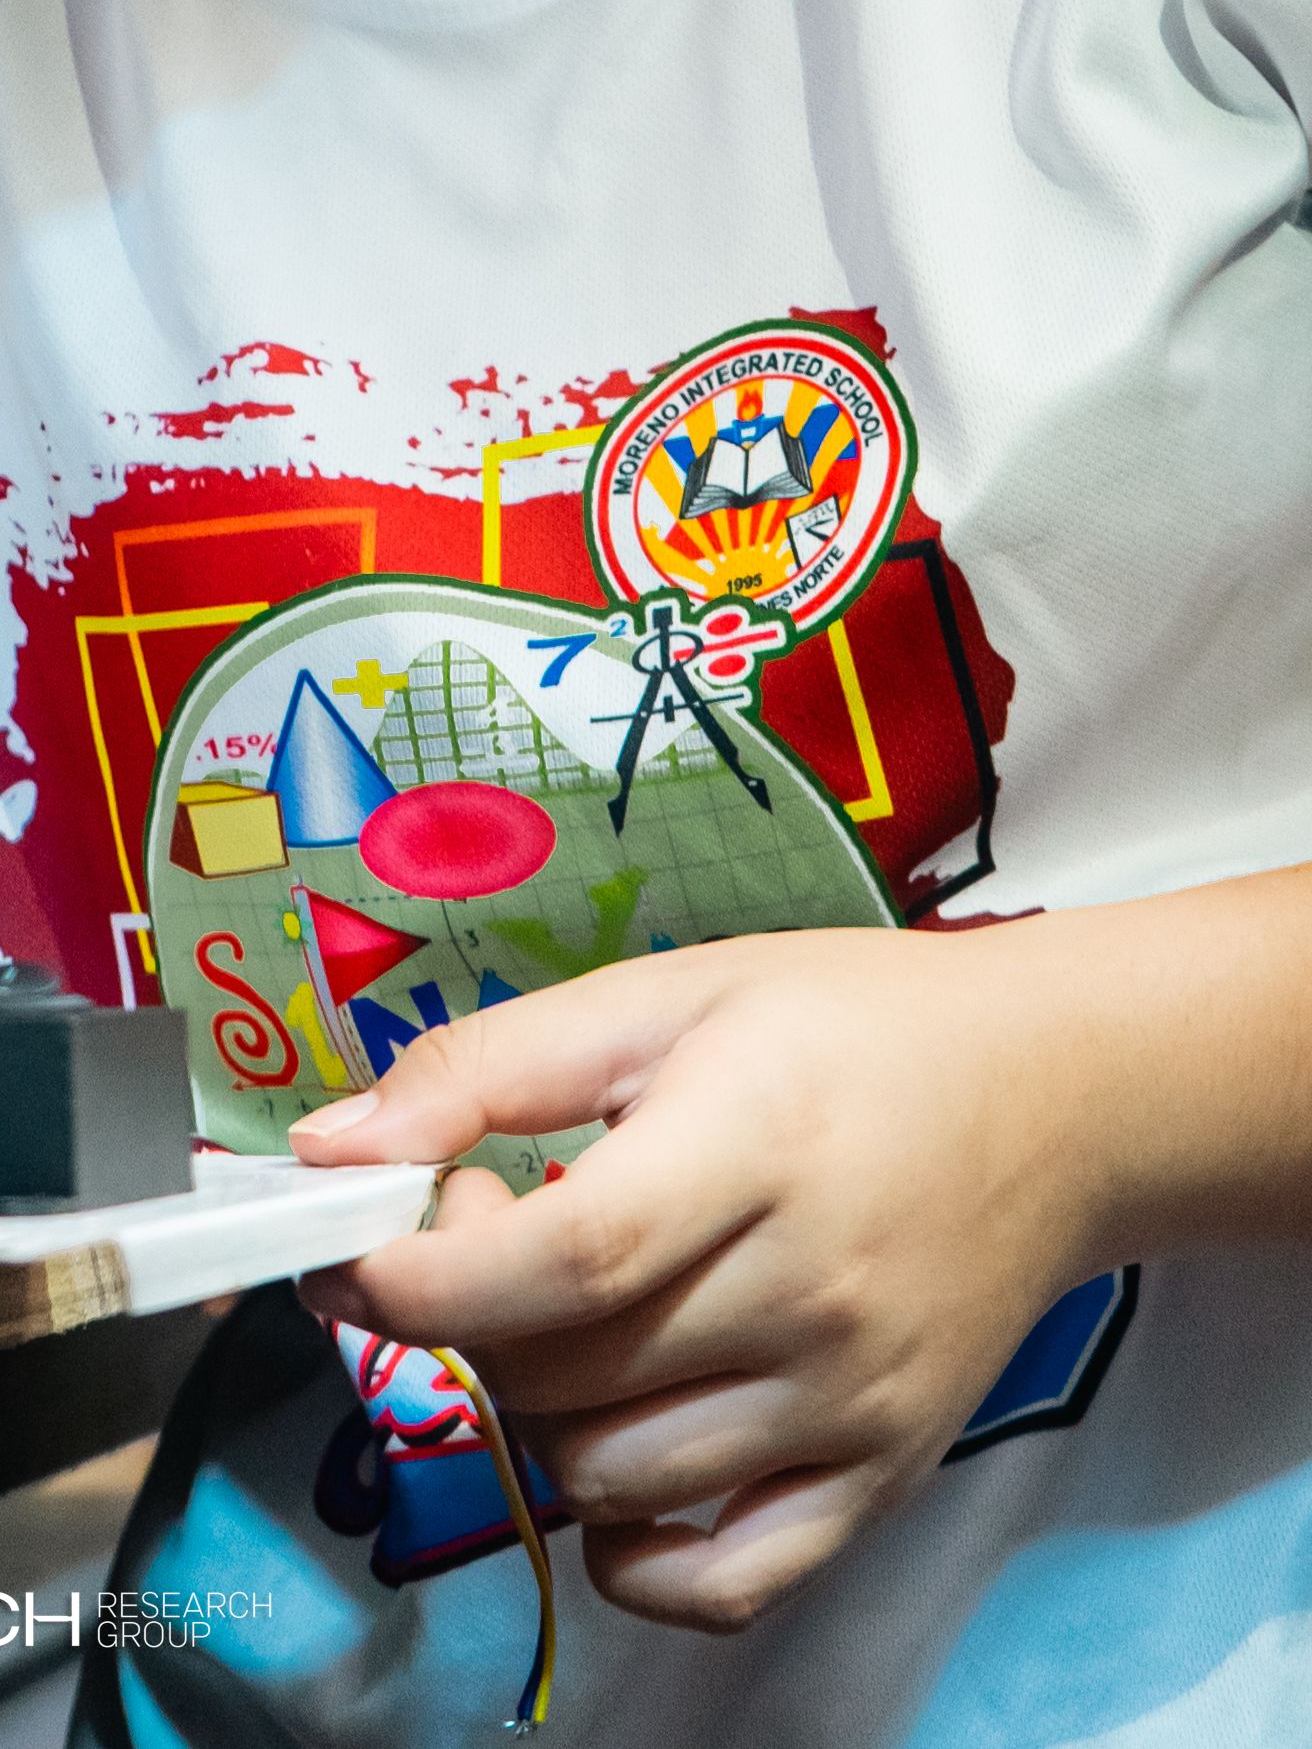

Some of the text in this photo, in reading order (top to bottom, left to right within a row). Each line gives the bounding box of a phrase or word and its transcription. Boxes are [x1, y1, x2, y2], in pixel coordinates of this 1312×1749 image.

[612, 352, 884, 496] MORENO INTEGRATED SCHOOL
[726, 573, 763, 594] 1995
[793, 545, 845, 599] NORTE
